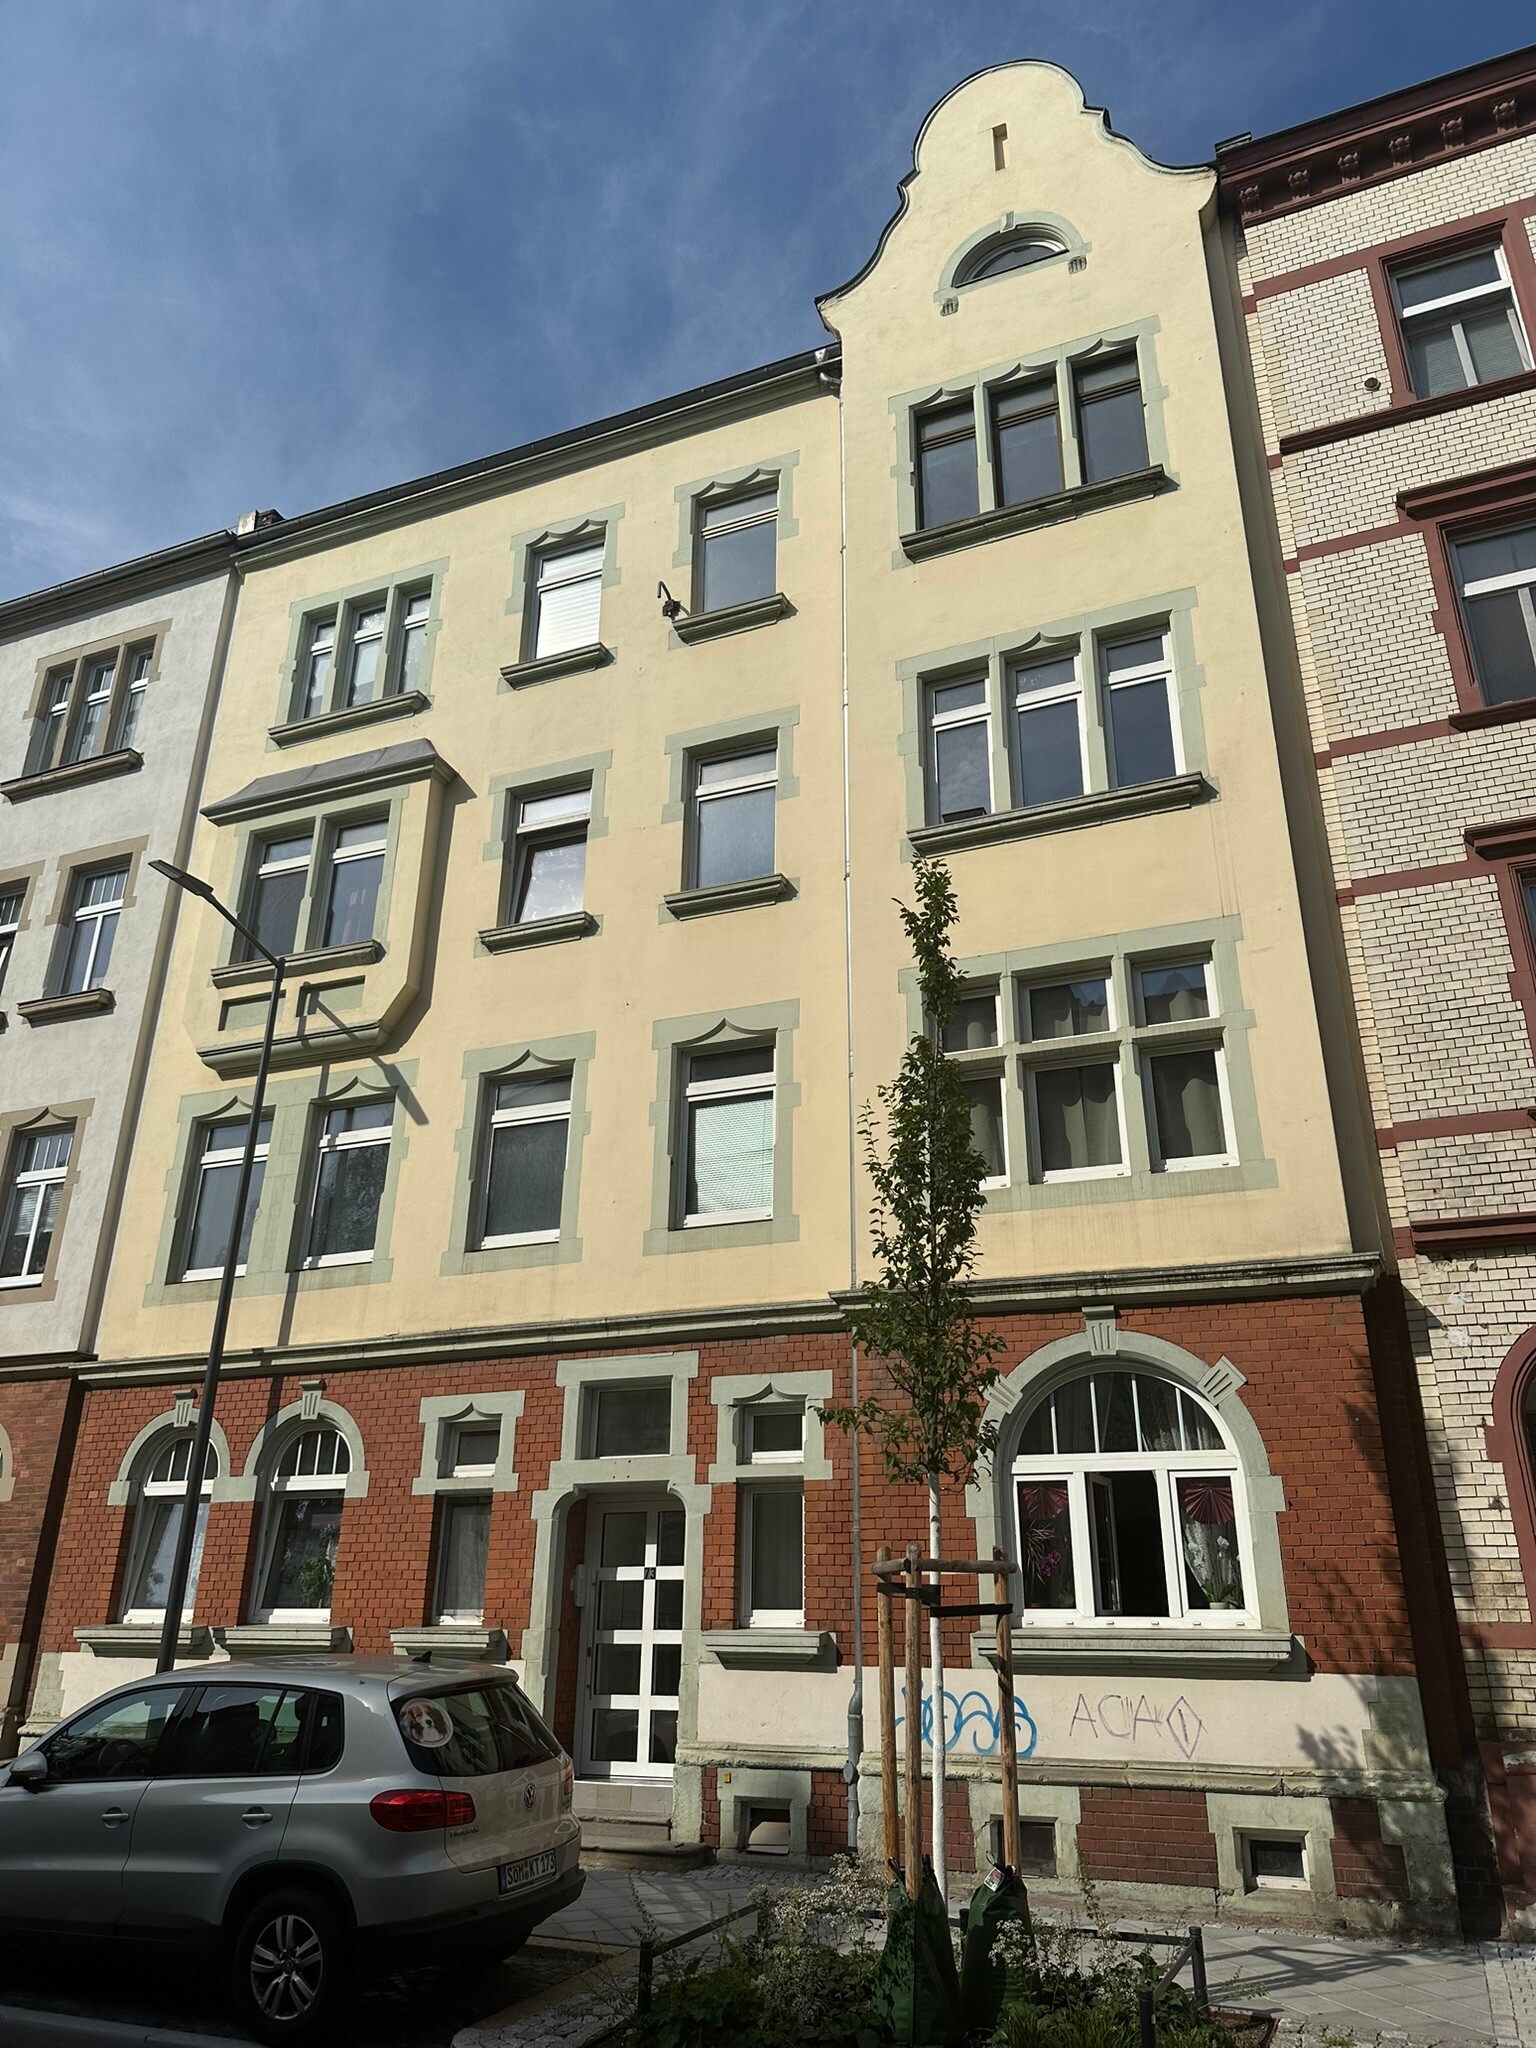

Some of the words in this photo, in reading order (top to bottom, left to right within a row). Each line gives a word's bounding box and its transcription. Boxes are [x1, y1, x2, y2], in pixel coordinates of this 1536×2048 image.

[644, 1567, 656, 1580] 73
[507, 1863, 525, 1885] SÖM
[529, 1857, 540, 1878] KT
[540, 1852, 555, 1873] 173
